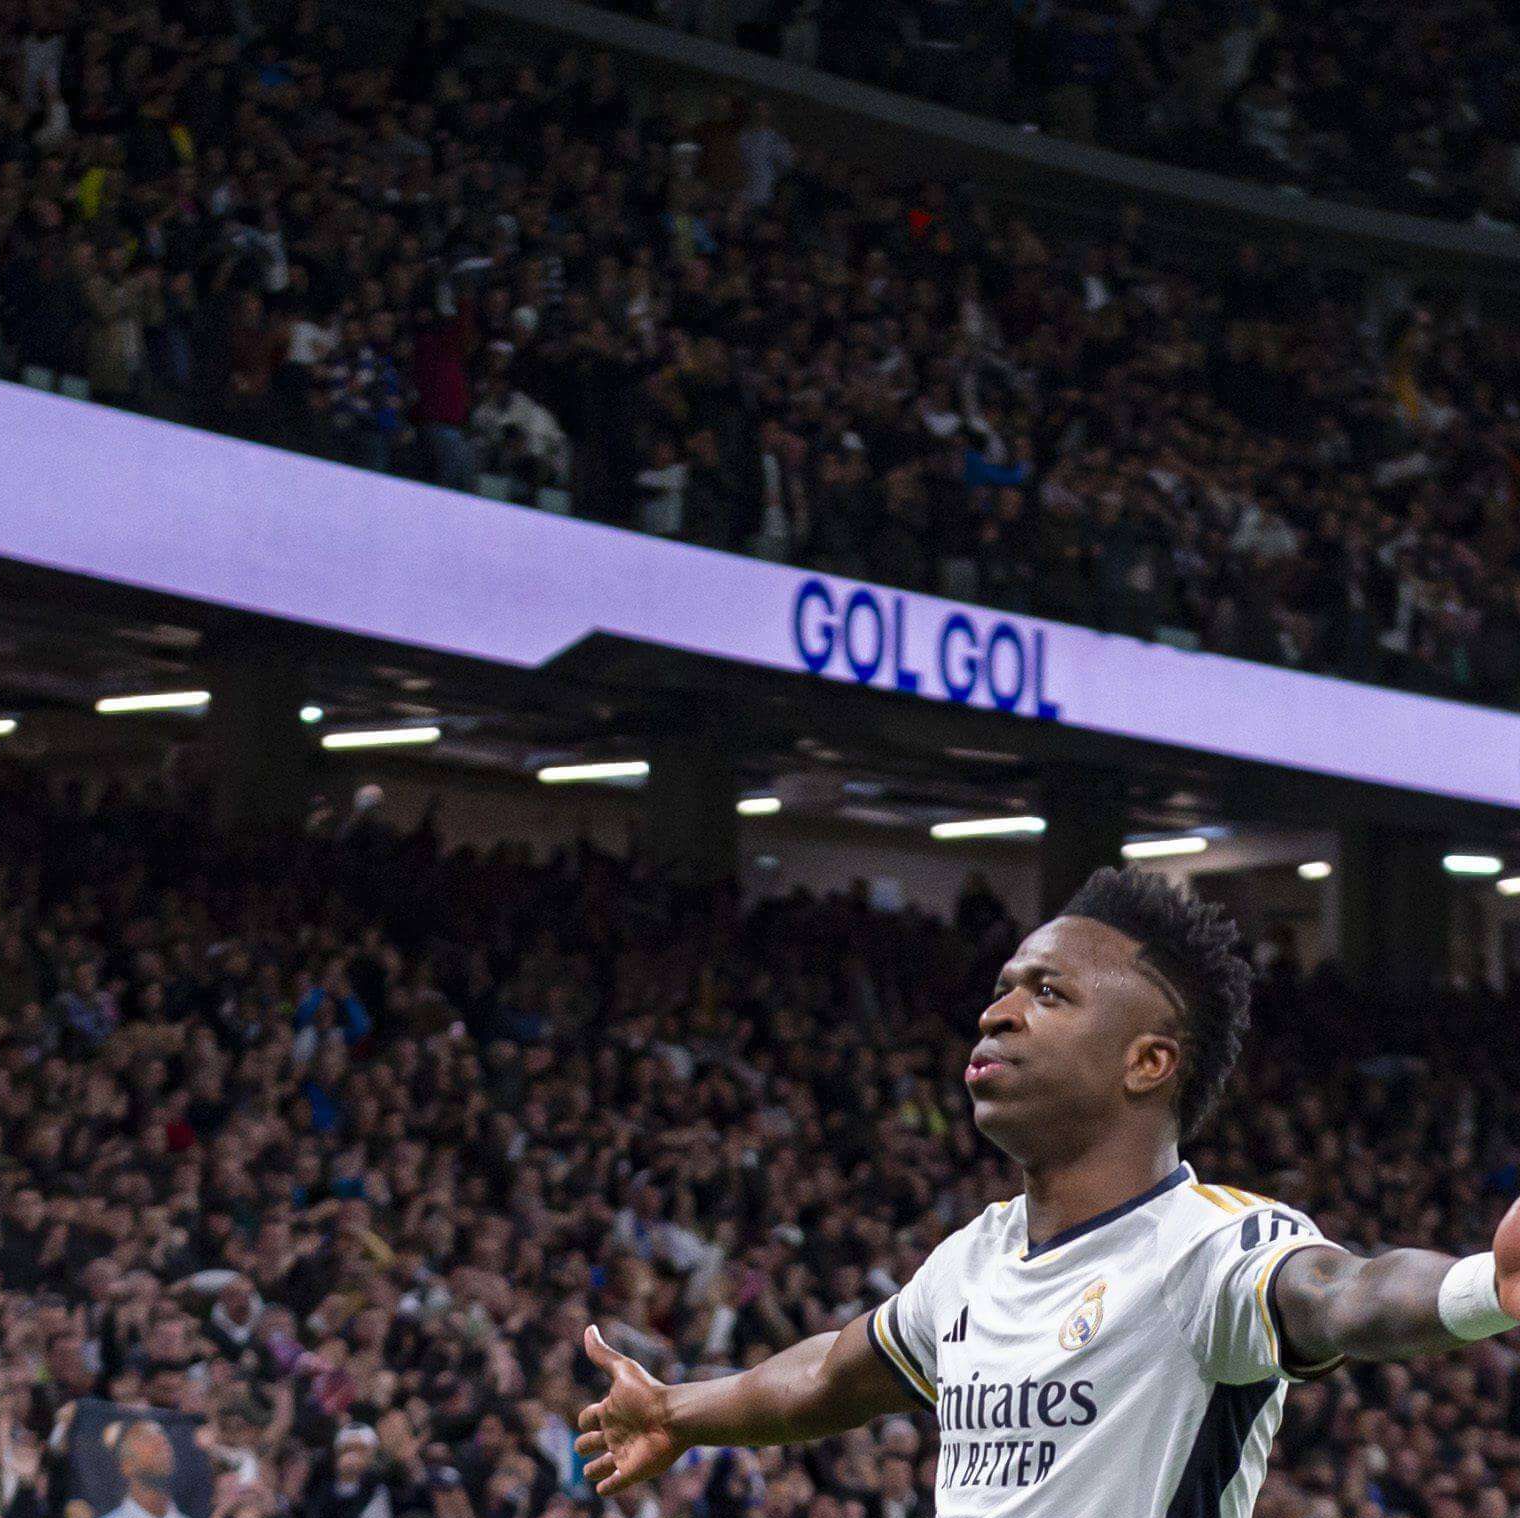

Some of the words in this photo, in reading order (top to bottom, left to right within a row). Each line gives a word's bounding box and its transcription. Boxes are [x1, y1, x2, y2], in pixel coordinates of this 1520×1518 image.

[794, 579, 919, 693] GOL
[939, 612, 1059, 721] GOL
[937, 1371, 1098, 1432] mirates
[960, 1440, 1057, 1487] BETTER
